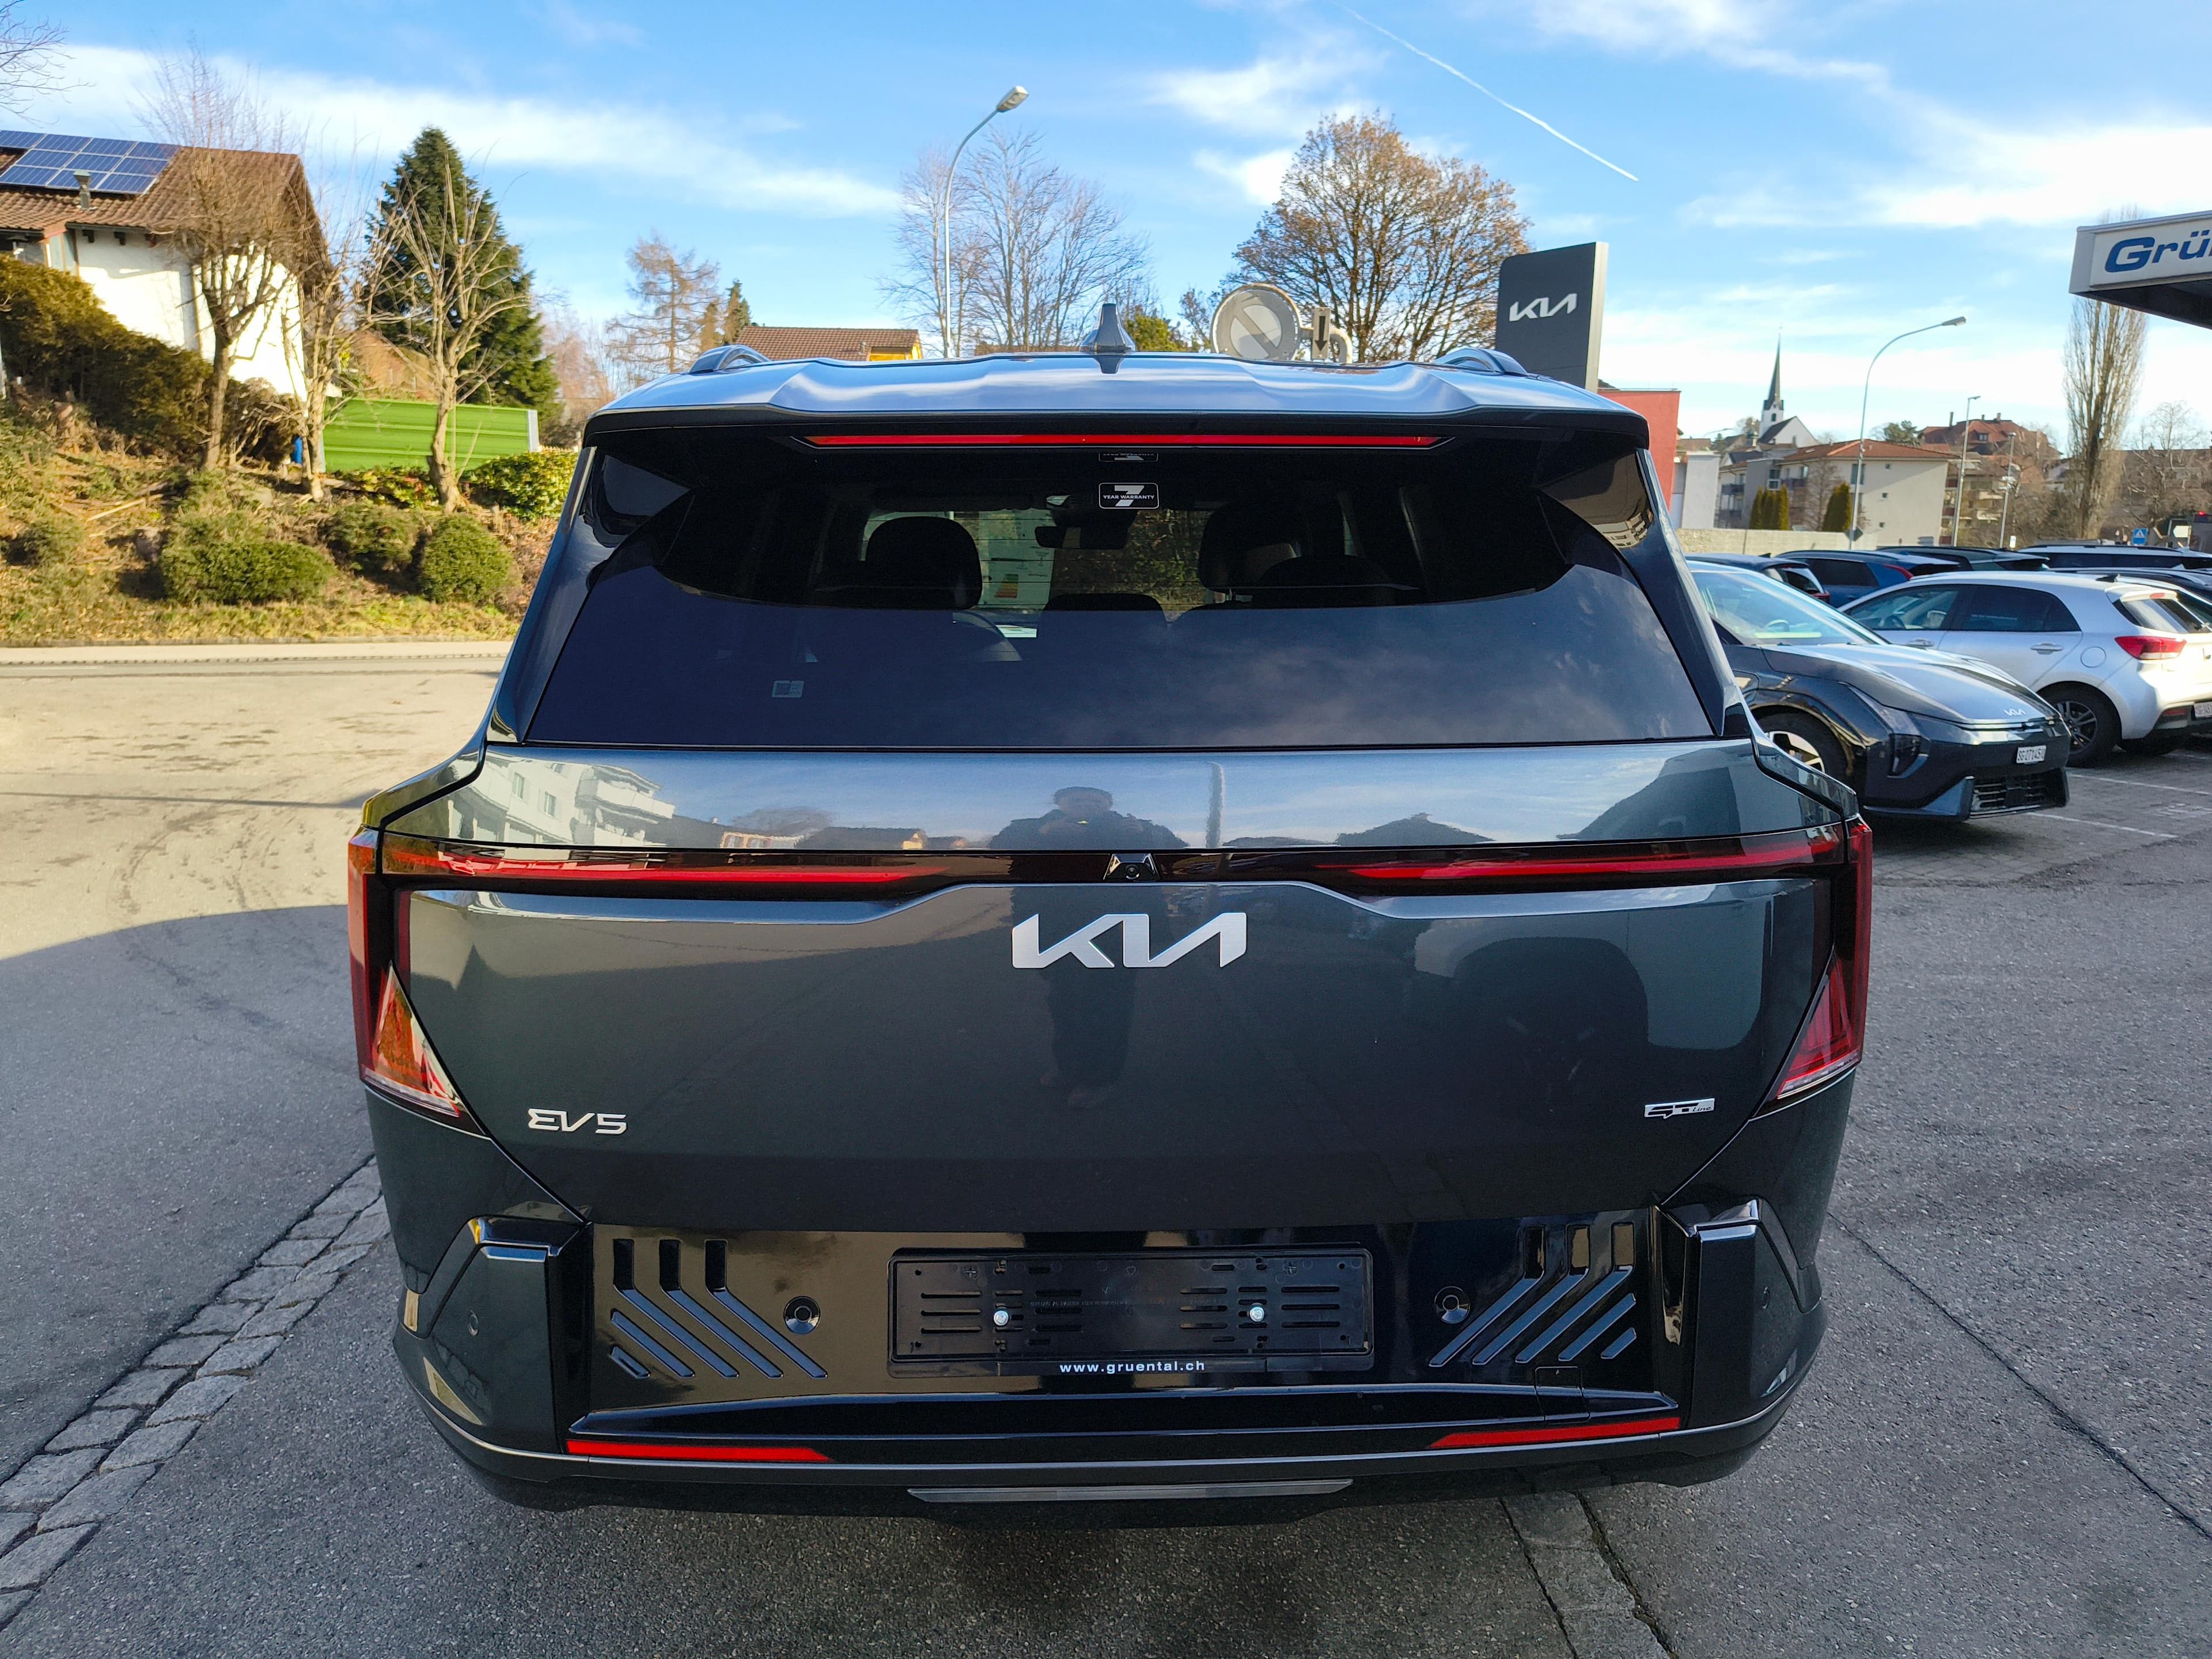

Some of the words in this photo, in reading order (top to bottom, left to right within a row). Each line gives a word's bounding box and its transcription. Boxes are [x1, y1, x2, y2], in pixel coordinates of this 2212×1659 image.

[2105, 230, 2212, 272] Grü
[1509, 293, 1577, 321] KIA
[1012, 912, 1247, 968] KIA
[528, 1108, 627, 1134] EV5
[1060, 1361, 1205, 1374] www.gruental.ch
